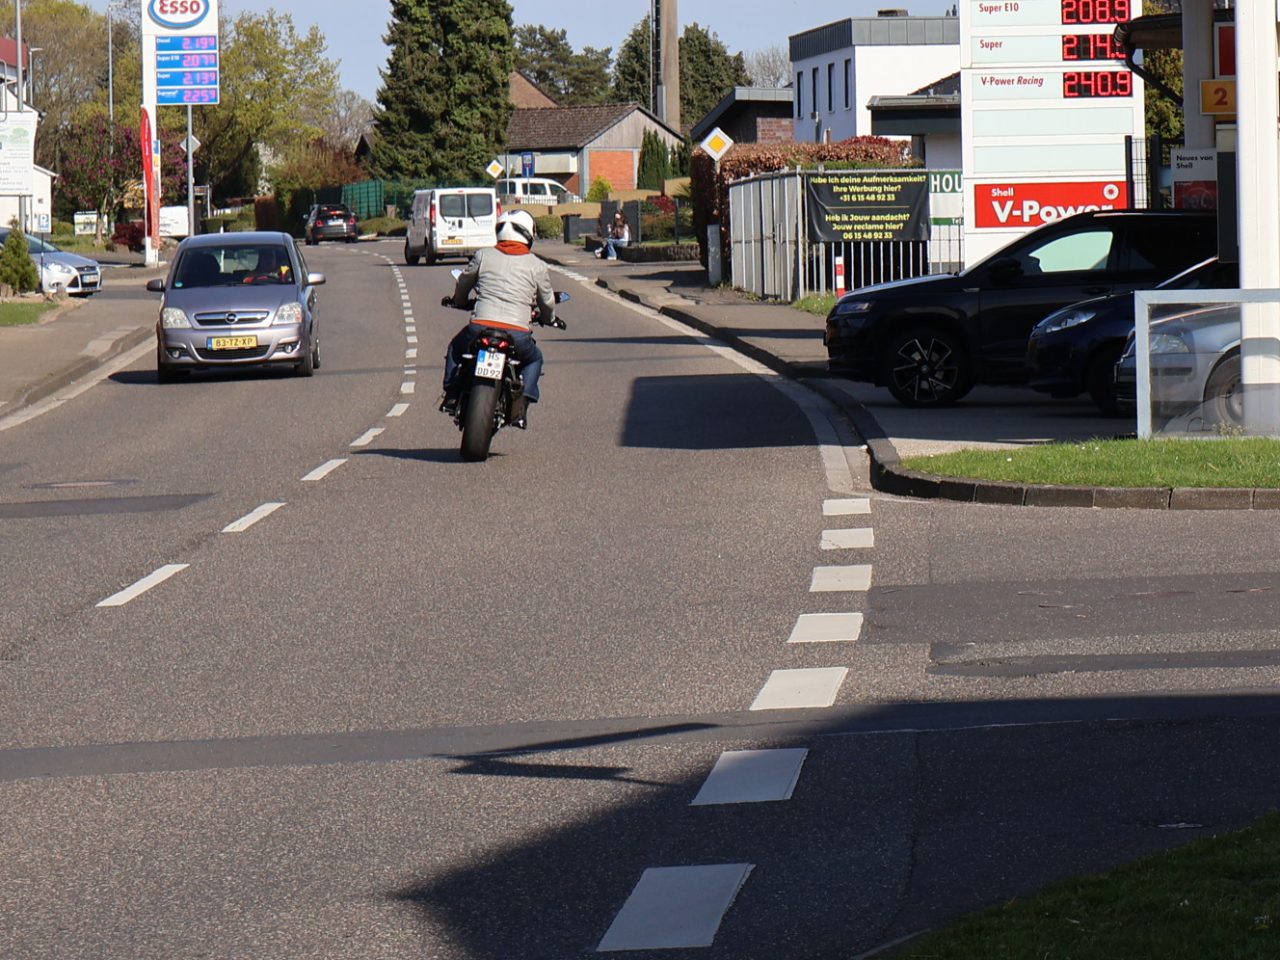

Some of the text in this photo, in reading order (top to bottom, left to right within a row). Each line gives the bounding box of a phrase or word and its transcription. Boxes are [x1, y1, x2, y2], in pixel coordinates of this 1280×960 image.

[979, 3, 1001, 14] Super
[1004, 2, 1019, 12] E10
[980, 39, 1003, 51] Super
[981, 71, 1131, 97] V-Power Racing 240.9
[1213, 86, 1228, 106] 2
[840, 176, 862, 184] deine
[862, 175, 926, 183] Aufmerksamkeit?
[931, 174, 963, 192] HOU
[848, 185, 882, 194] Werbung
[883, 184, 902, 192] hier?
[991, 187, 1014, 197] Shell
[886, 193, 896, 201] 33
[825, 214, 840, 222] Heb
[871, 213, 910, 221] aandacht?
[832, 223, 853, 231] Jouw
[873, 231, 883, 239] 92
[883, 231, 893, 239] 33
[477, 367, 501, 378] DD 92
